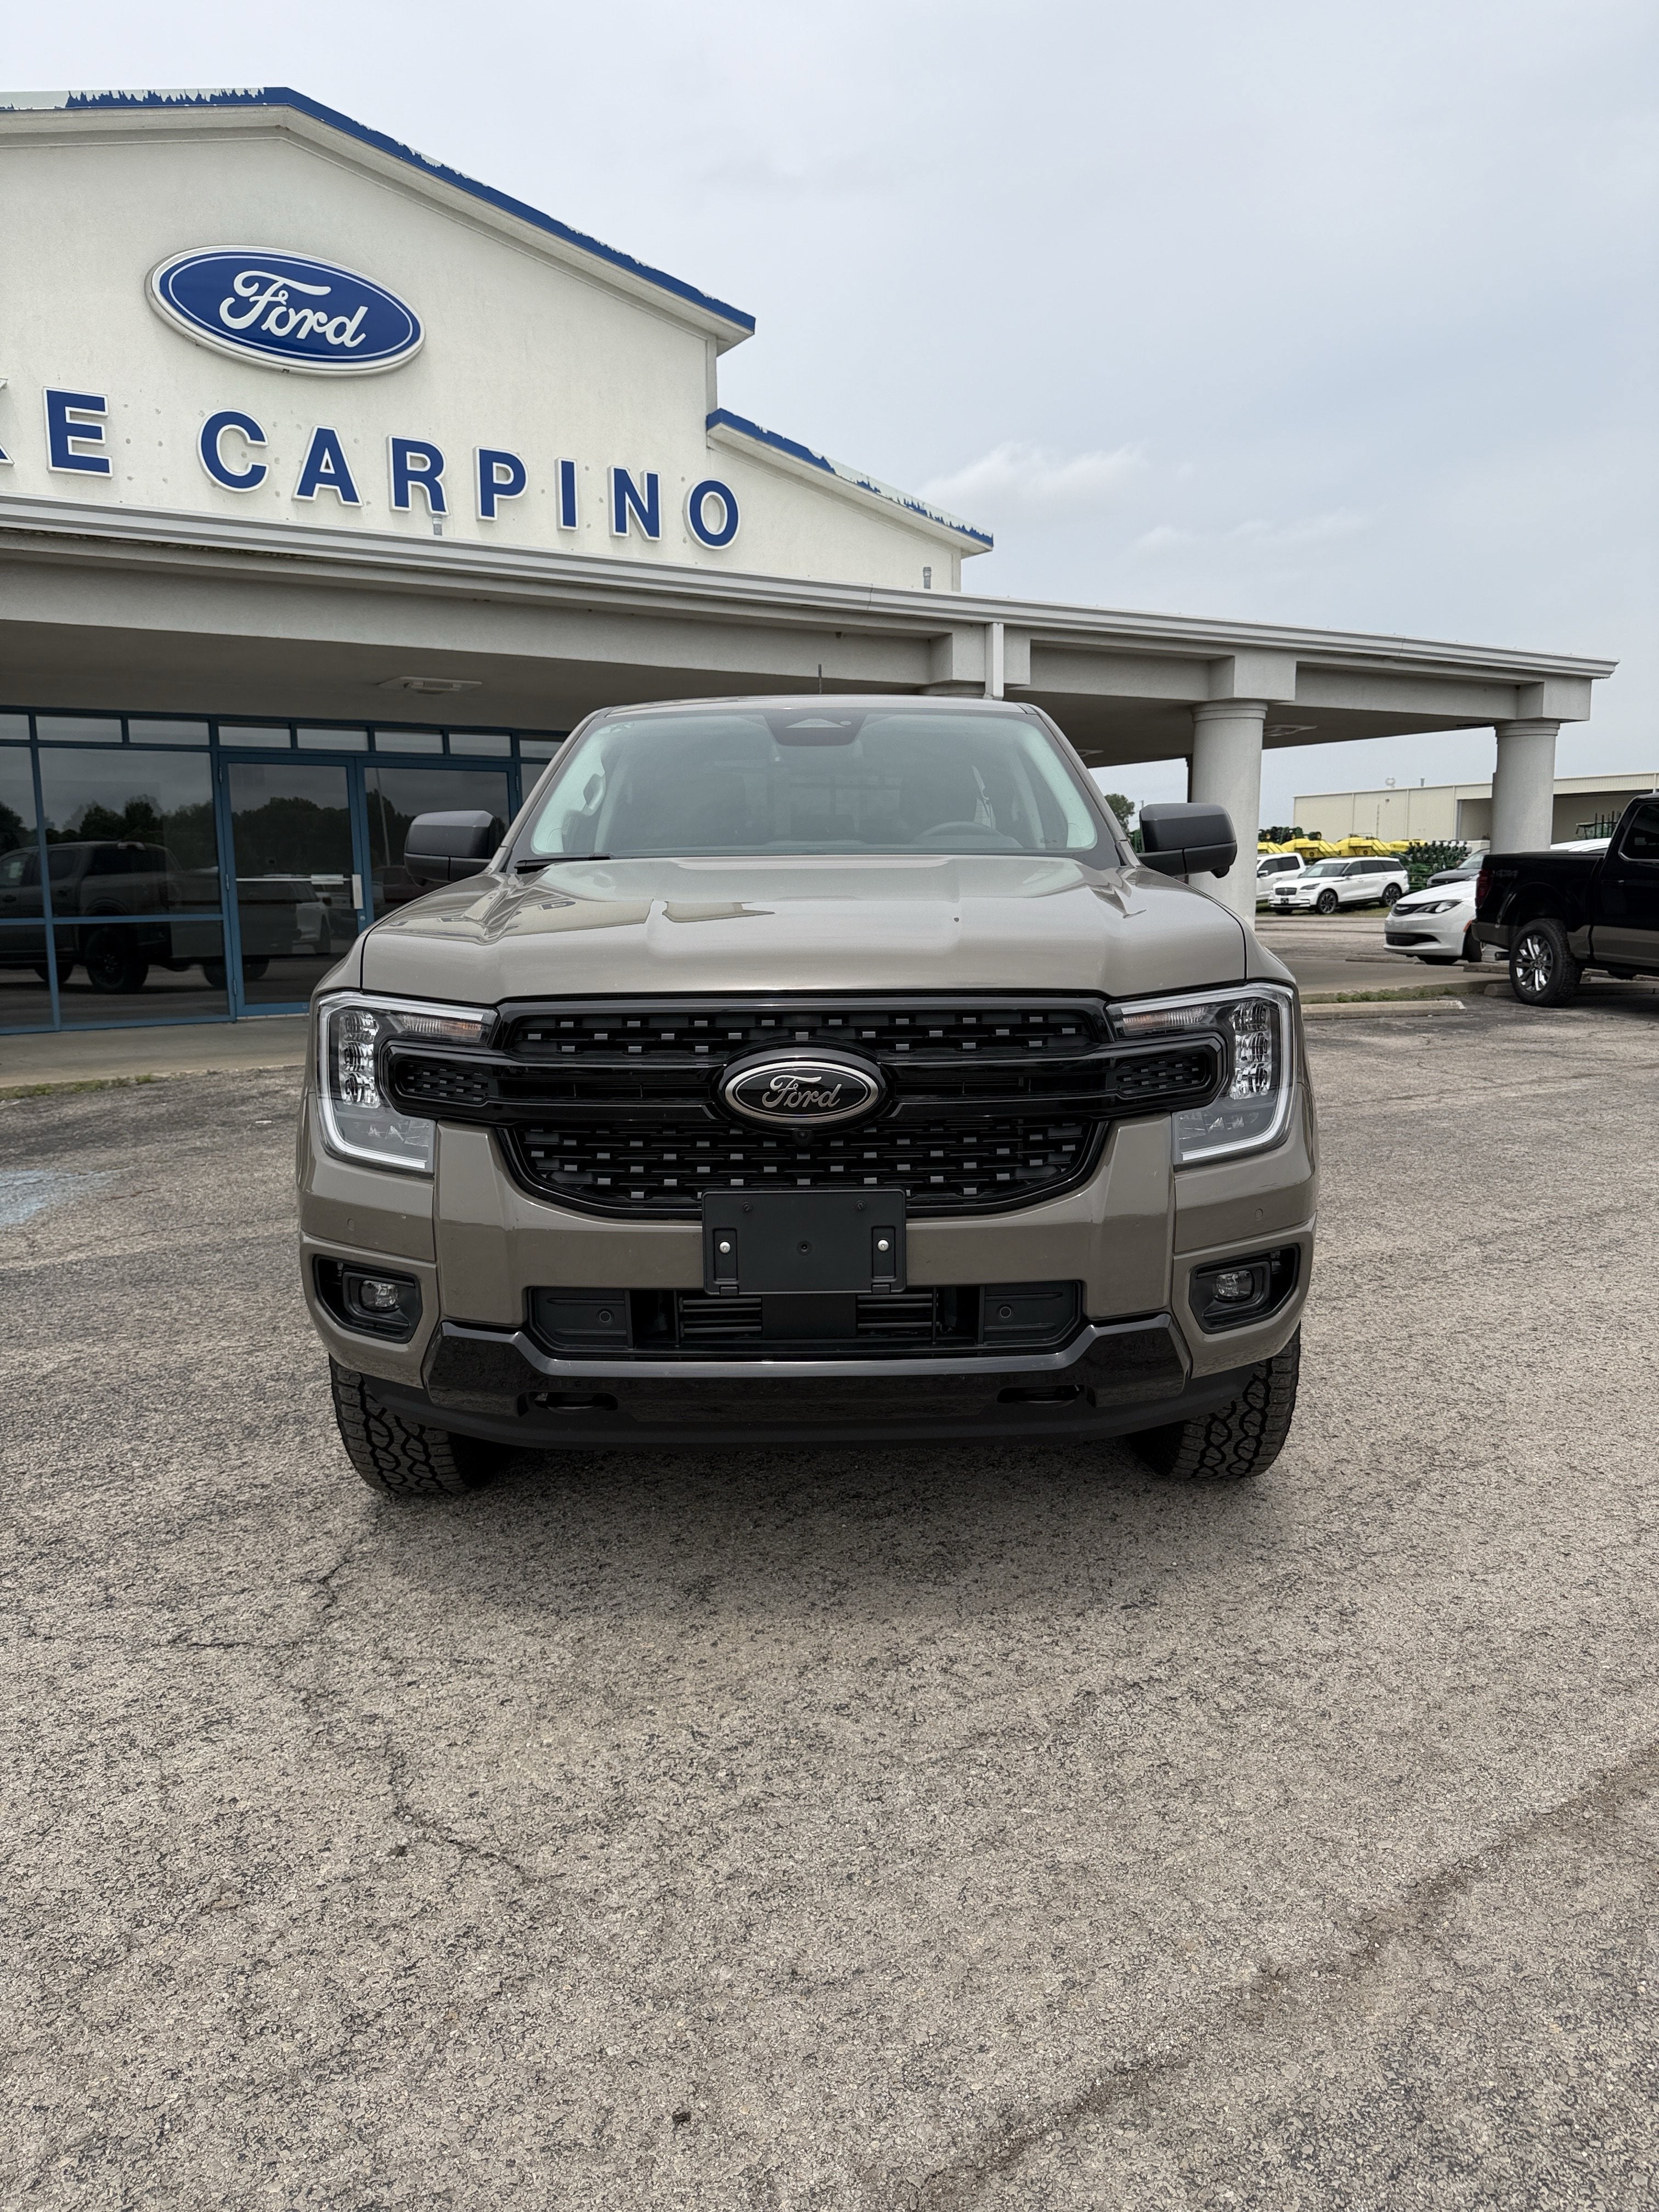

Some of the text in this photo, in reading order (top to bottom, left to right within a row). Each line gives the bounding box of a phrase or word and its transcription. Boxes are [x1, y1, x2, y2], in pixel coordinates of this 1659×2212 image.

[219, 270, 368, 348] Ford
[0, 377, 741, 550] E CARPINO
[761, 1075, 842, 1108] Ford
